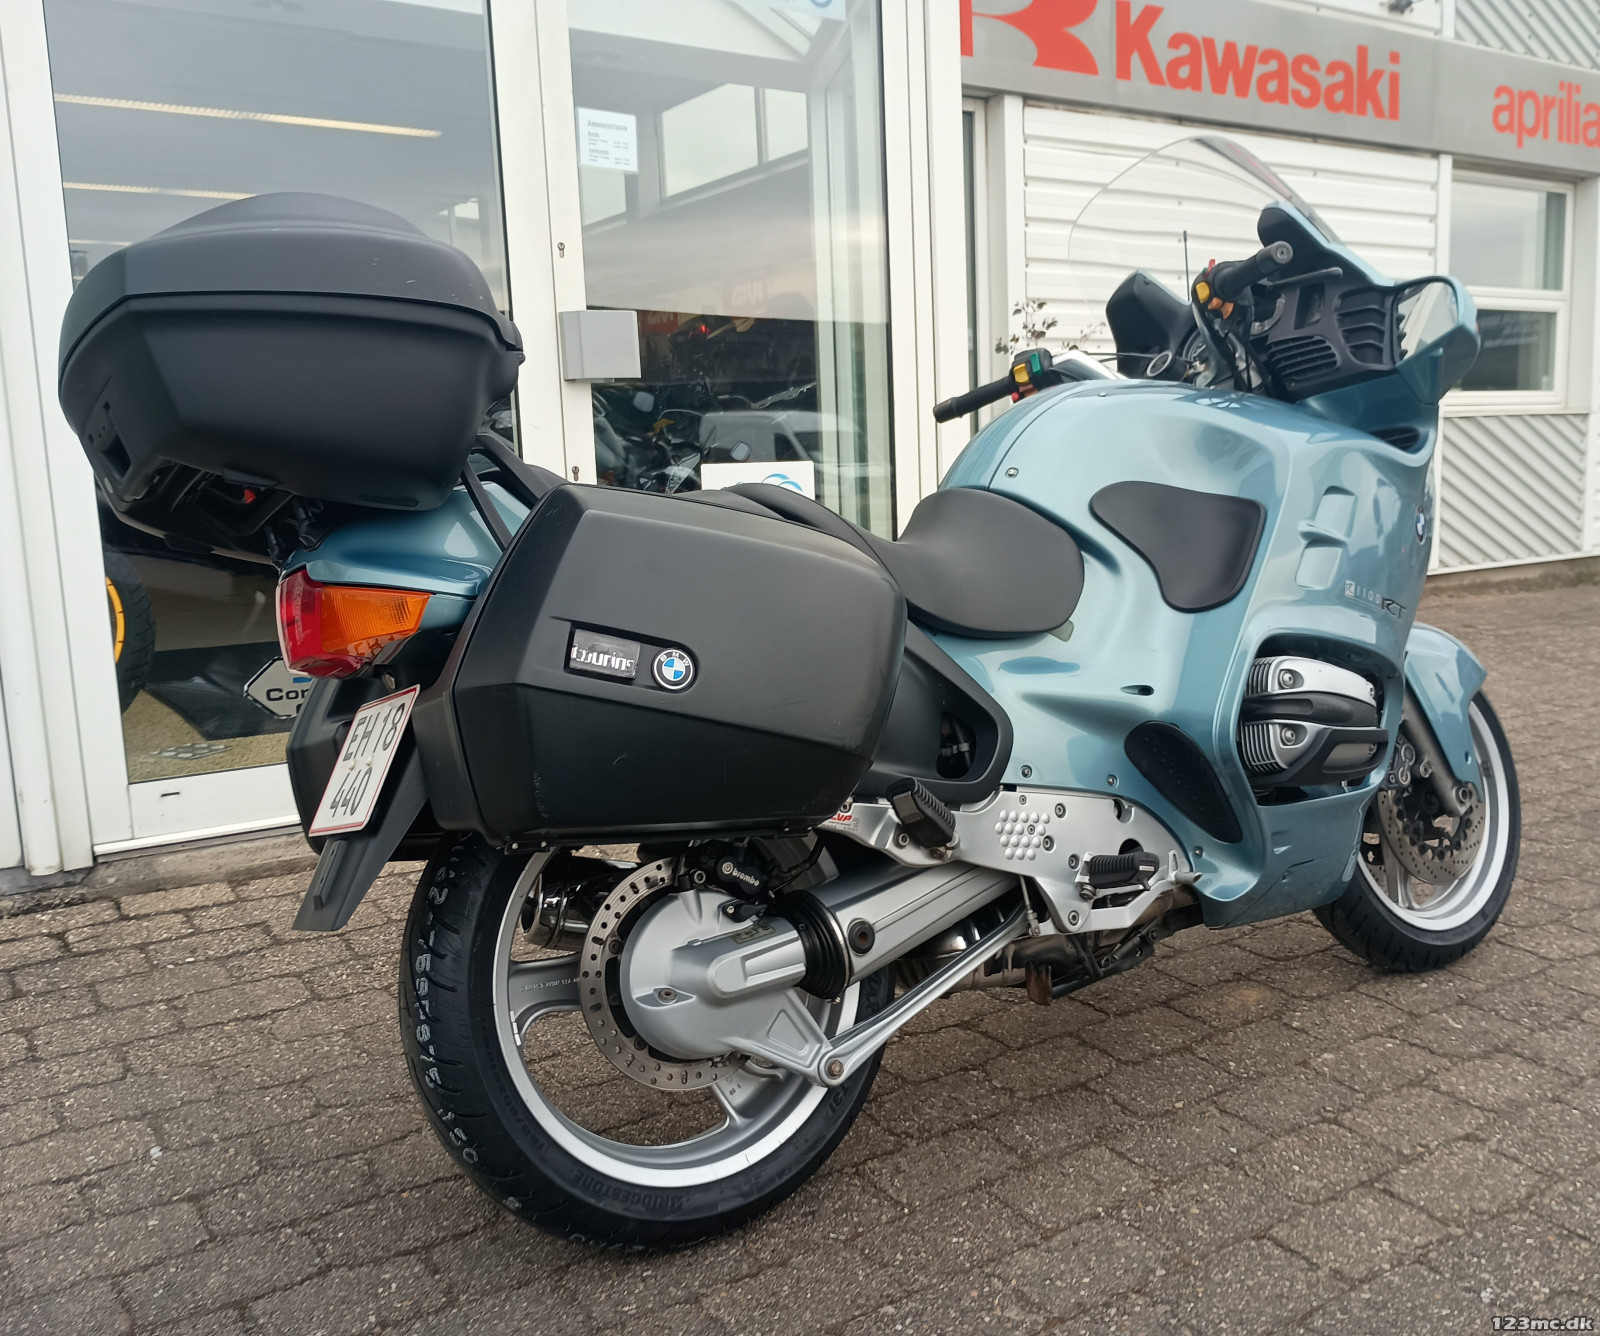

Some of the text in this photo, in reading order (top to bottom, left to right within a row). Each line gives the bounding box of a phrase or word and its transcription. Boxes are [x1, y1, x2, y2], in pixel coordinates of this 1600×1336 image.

[1115, 0, 1400, 120] Kawasaki
[1492, 80, 1600, 149] aprilia
[343, 702, 406, 762] EH 18
[329, 767, 373, 818] 440
[732, 867, 760, 887] brembo
[573, 1168, 688, 1210] BRIDGESTONE
